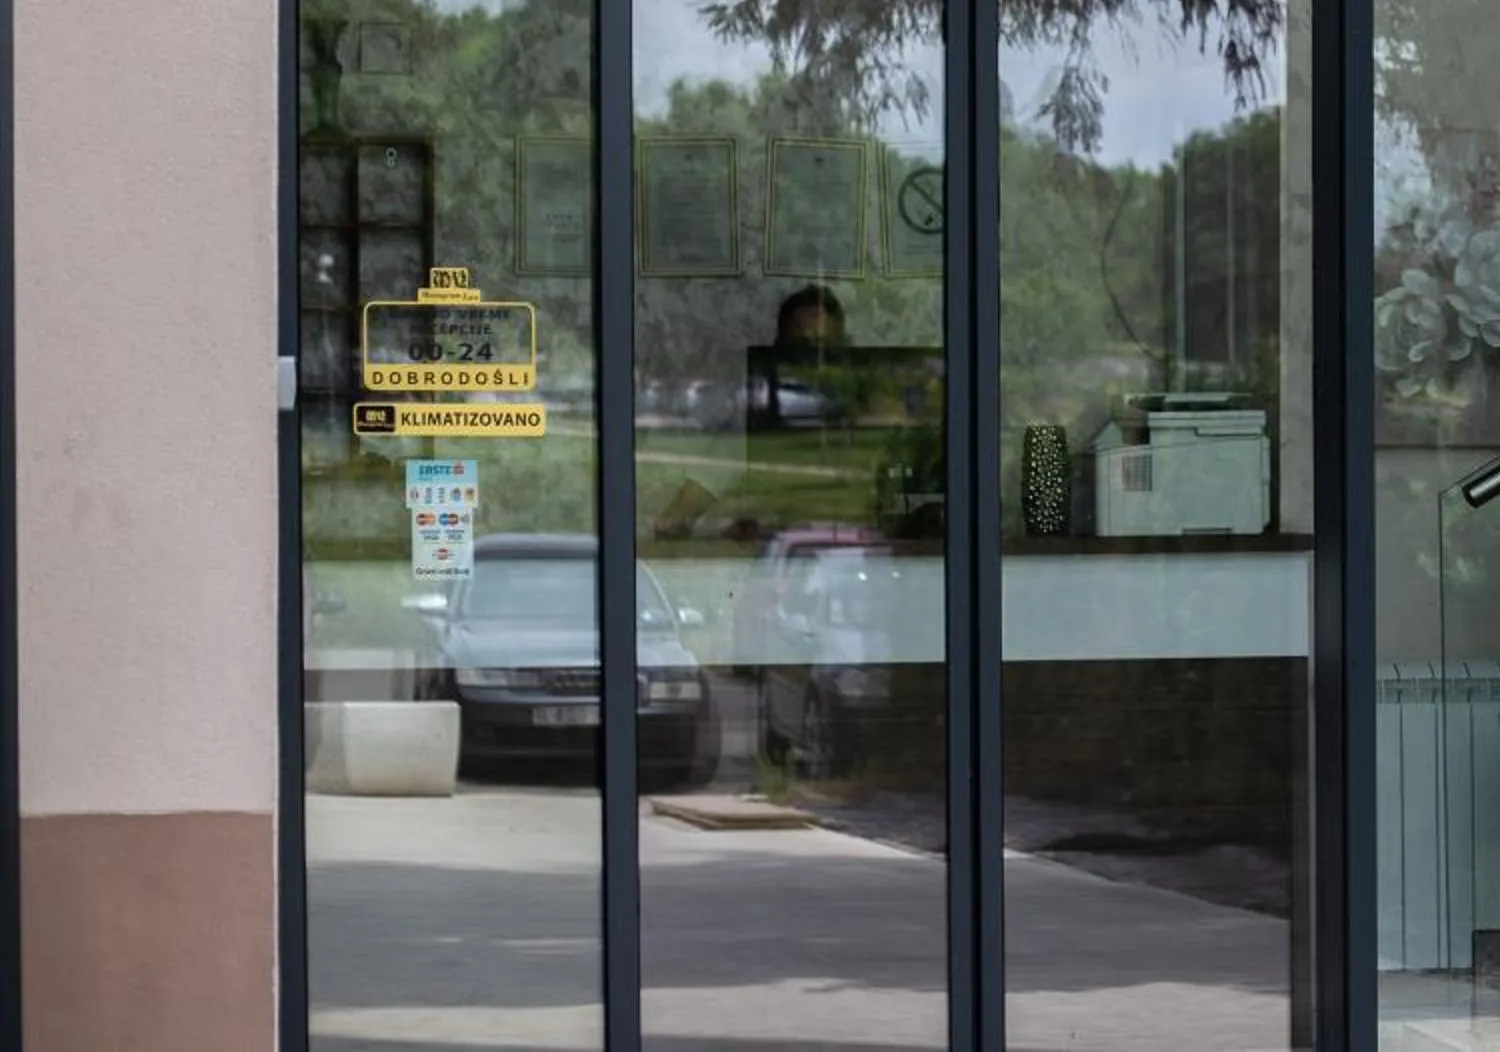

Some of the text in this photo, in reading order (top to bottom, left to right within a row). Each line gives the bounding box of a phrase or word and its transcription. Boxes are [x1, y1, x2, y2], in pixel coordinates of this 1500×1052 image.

[408, 343, 493, 361] 00-24
[372, 369, 529, 385] DOBRODOŠLI
[400, 411, 542, 427] KLIMATIZOVANO
